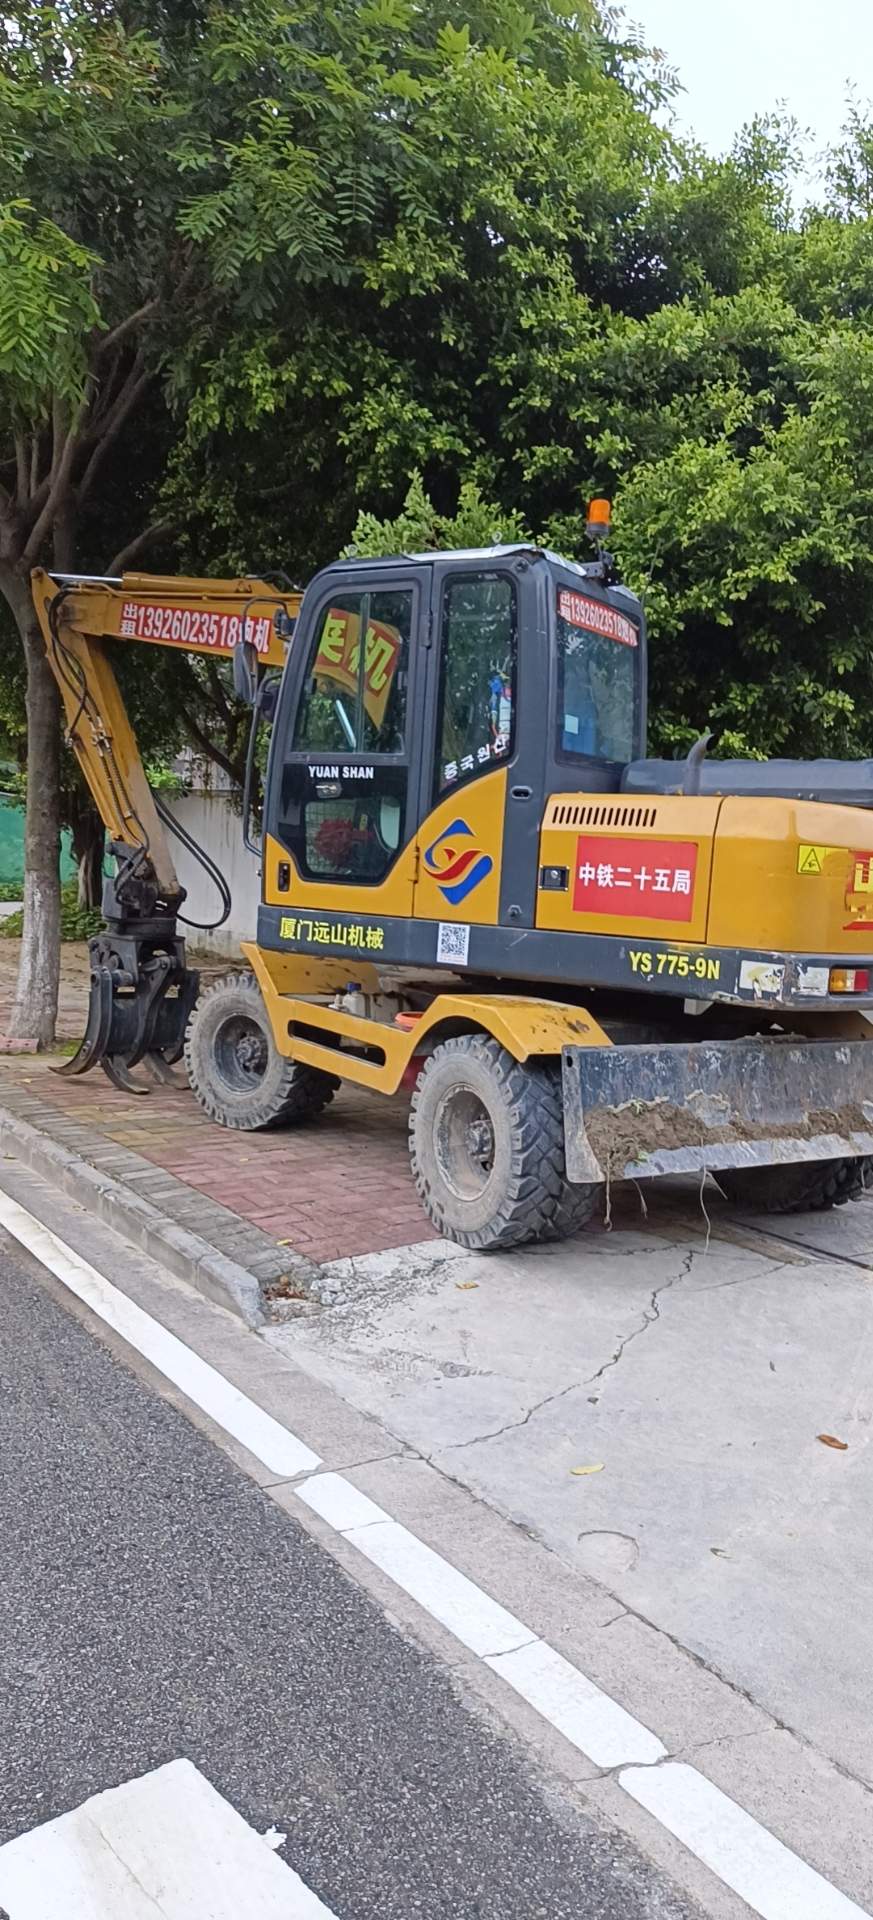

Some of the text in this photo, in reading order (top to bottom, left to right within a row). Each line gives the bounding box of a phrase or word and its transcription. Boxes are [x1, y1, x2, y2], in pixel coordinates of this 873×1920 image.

[120, 603, 138, 635] 出租
[137, 606, 239, 648] 13926023518
[308, 765, 374, 779] YUAN SHAN
[579, 861, 691, 895] 中铁二十五局
[279, 916, 385, 950] 厦门远山机械
[628, 951, 721, 980] YS 775-9N
